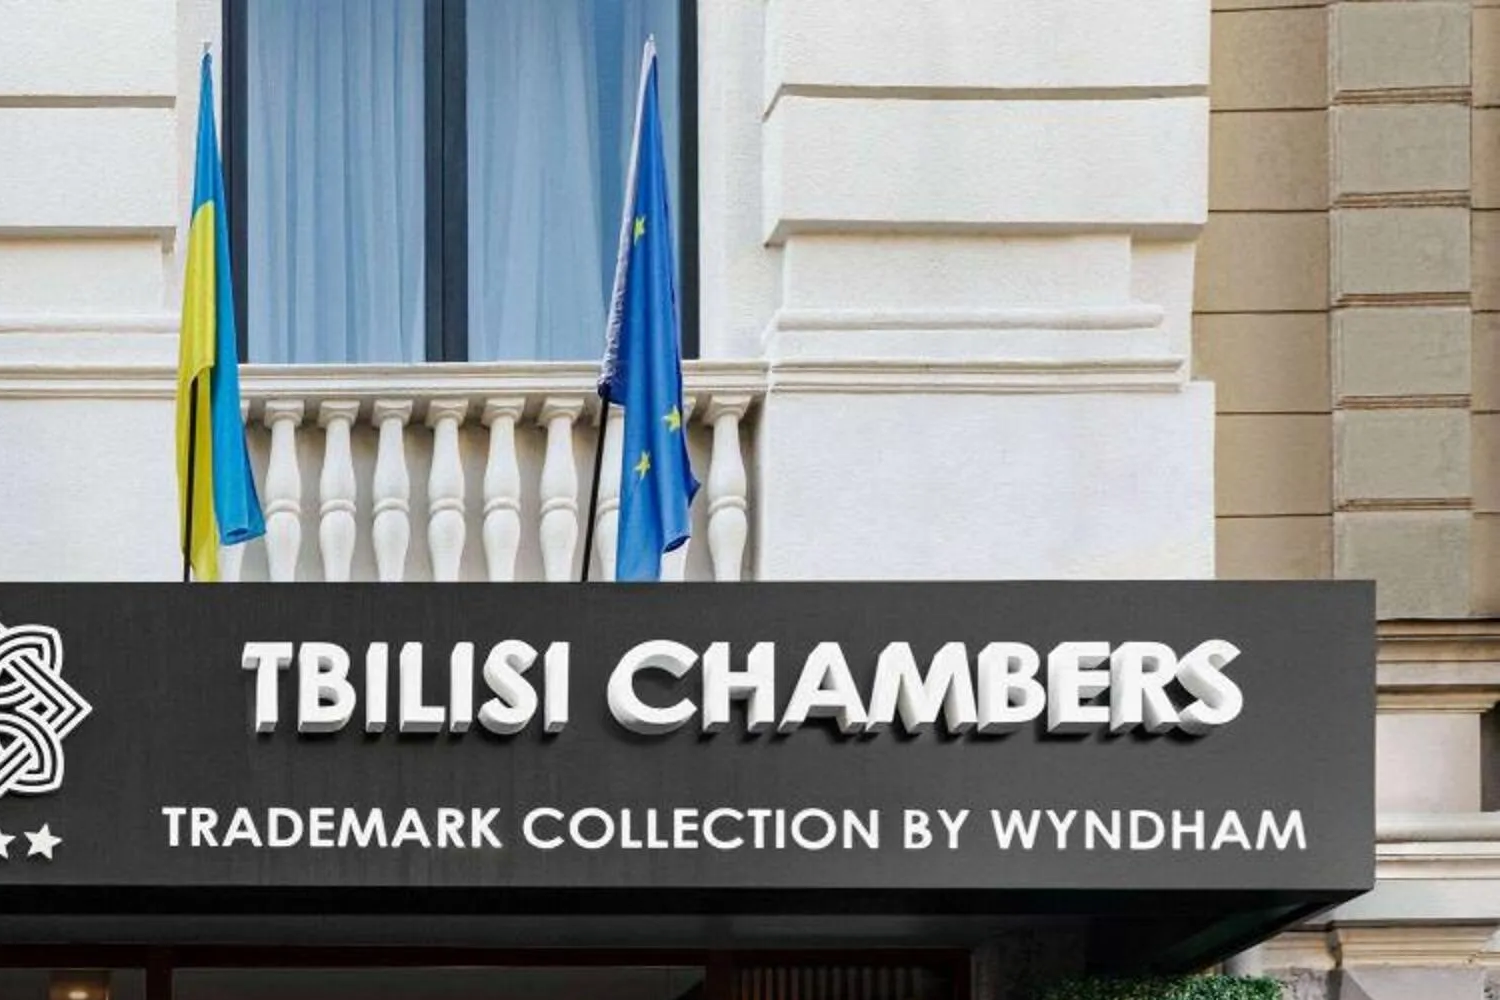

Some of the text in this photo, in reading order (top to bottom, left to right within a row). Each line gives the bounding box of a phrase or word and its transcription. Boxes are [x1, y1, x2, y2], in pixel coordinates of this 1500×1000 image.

[242, 638, 1245, 735] TBILISI CHAMBERS
[162, 807, 1308, 852] TRADEMARK COLLECTION BY WYNDHAM
